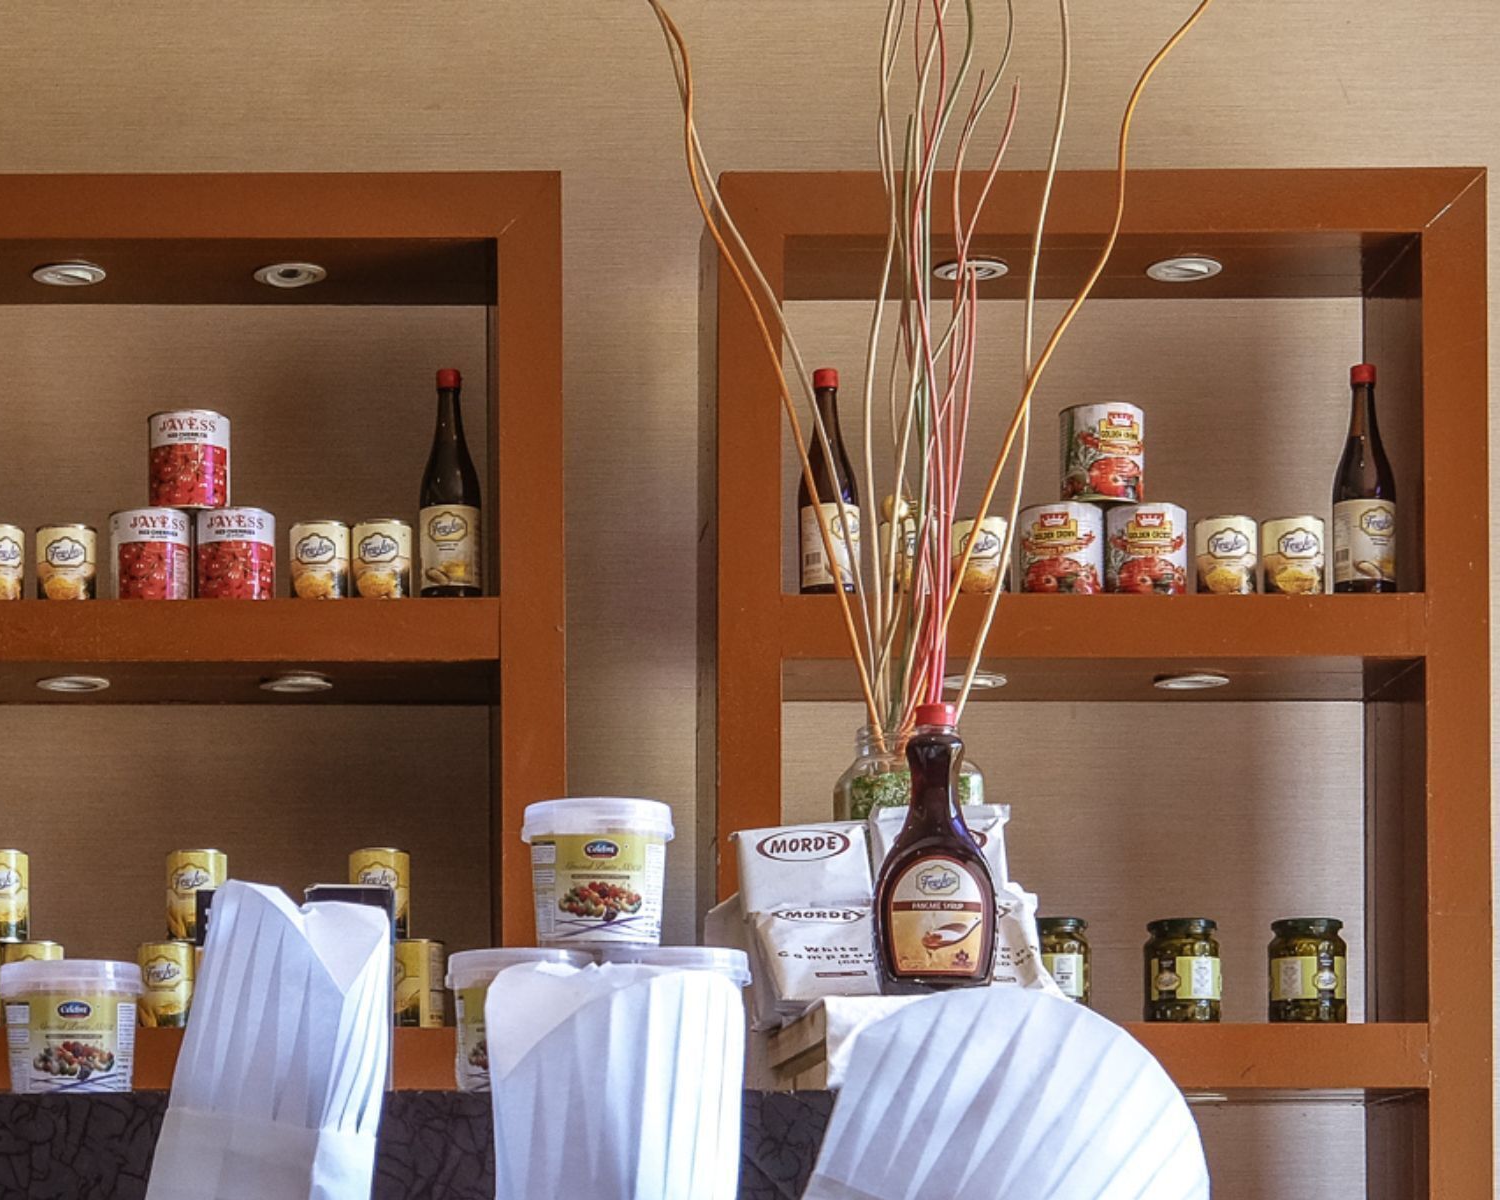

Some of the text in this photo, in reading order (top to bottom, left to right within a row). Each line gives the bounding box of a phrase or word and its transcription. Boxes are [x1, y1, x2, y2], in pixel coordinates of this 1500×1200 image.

[159, 416, 217, 432] JAYESS
[129, 515, 186, 530] JAYESS
[207, 515, 264, 530] JAYESS
[770, 836, 837, 854] MORDE
[785, 911, 852, 920] MORDE
